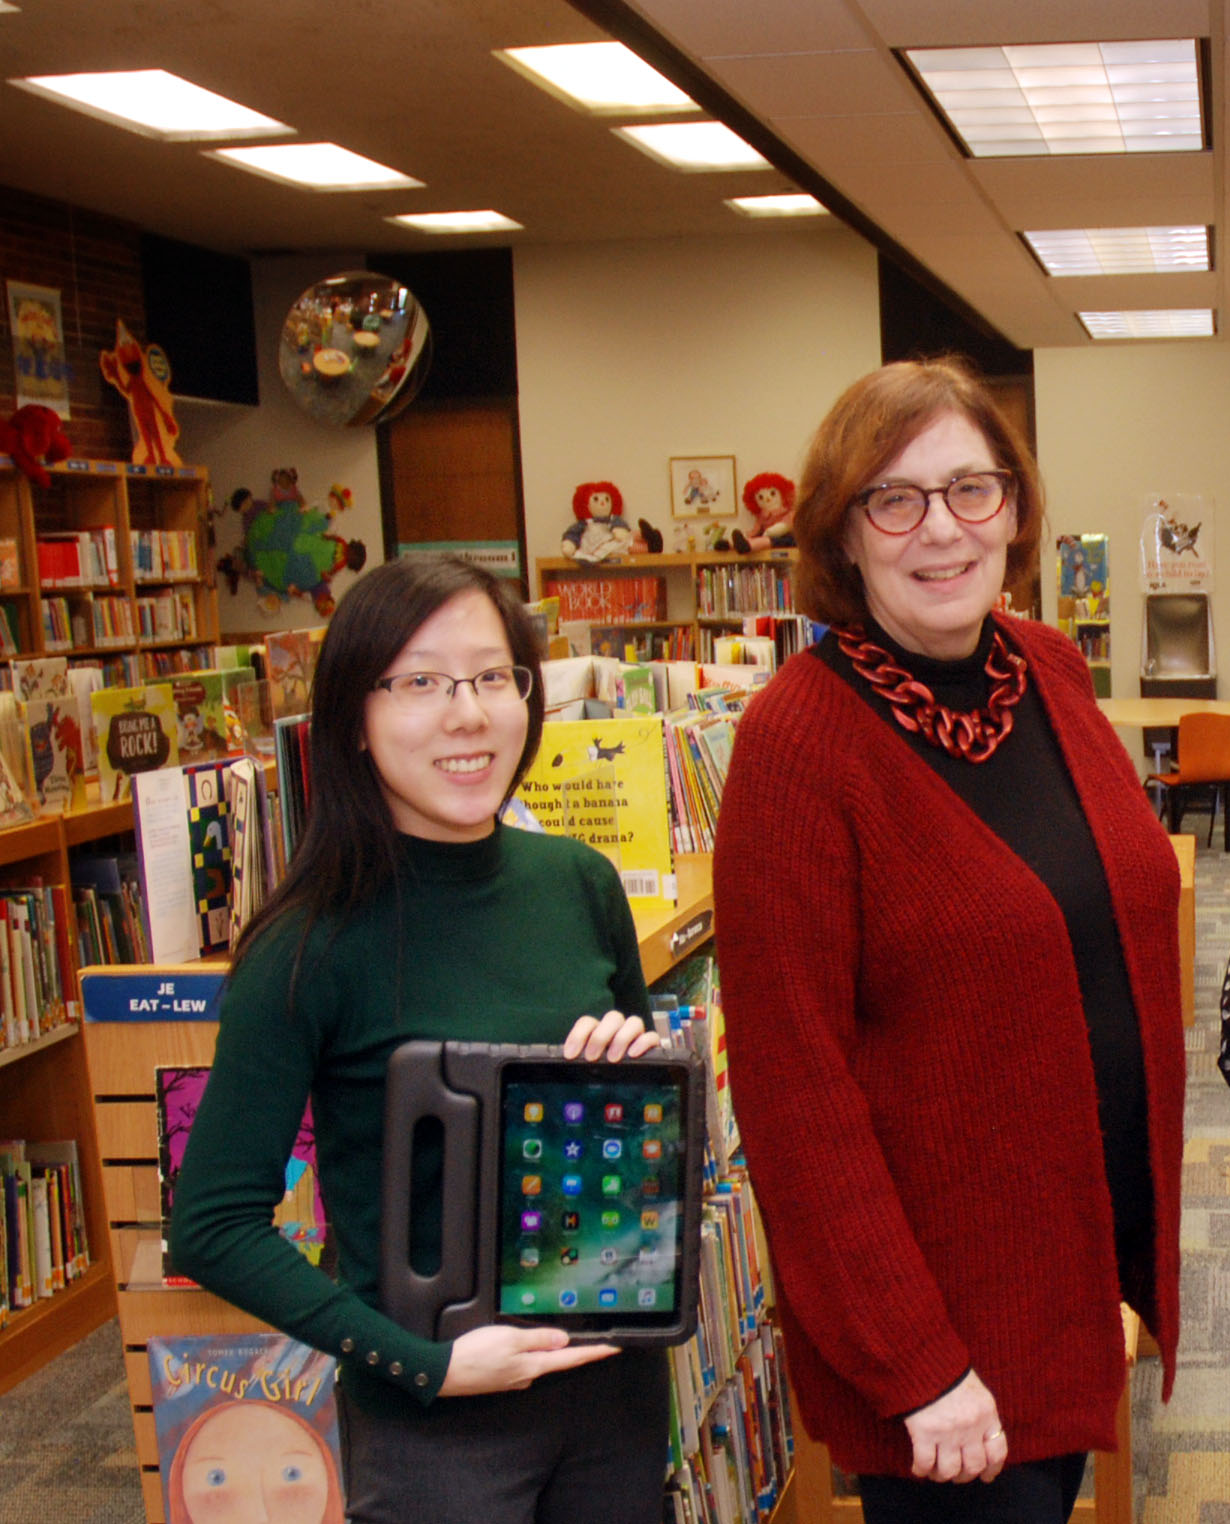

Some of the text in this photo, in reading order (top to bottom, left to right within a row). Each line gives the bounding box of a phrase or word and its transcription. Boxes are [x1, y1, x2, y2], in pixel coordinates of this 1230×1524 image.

[120, 731, 158, 758] ROCK!
[522, 781, 549, 792] Who
[552, 779, 593, 791] would
[523, 799, 570, 812] hought
[572, 800, 581, 808] a
[579, 817, 614, 826] cause
[157, 982, 175, 996] JE
[129, 999, 160, 1013] EAT
[172, 999, 207, 1013] LEW
[163, 1352, 322, 1406] Circus Girl
